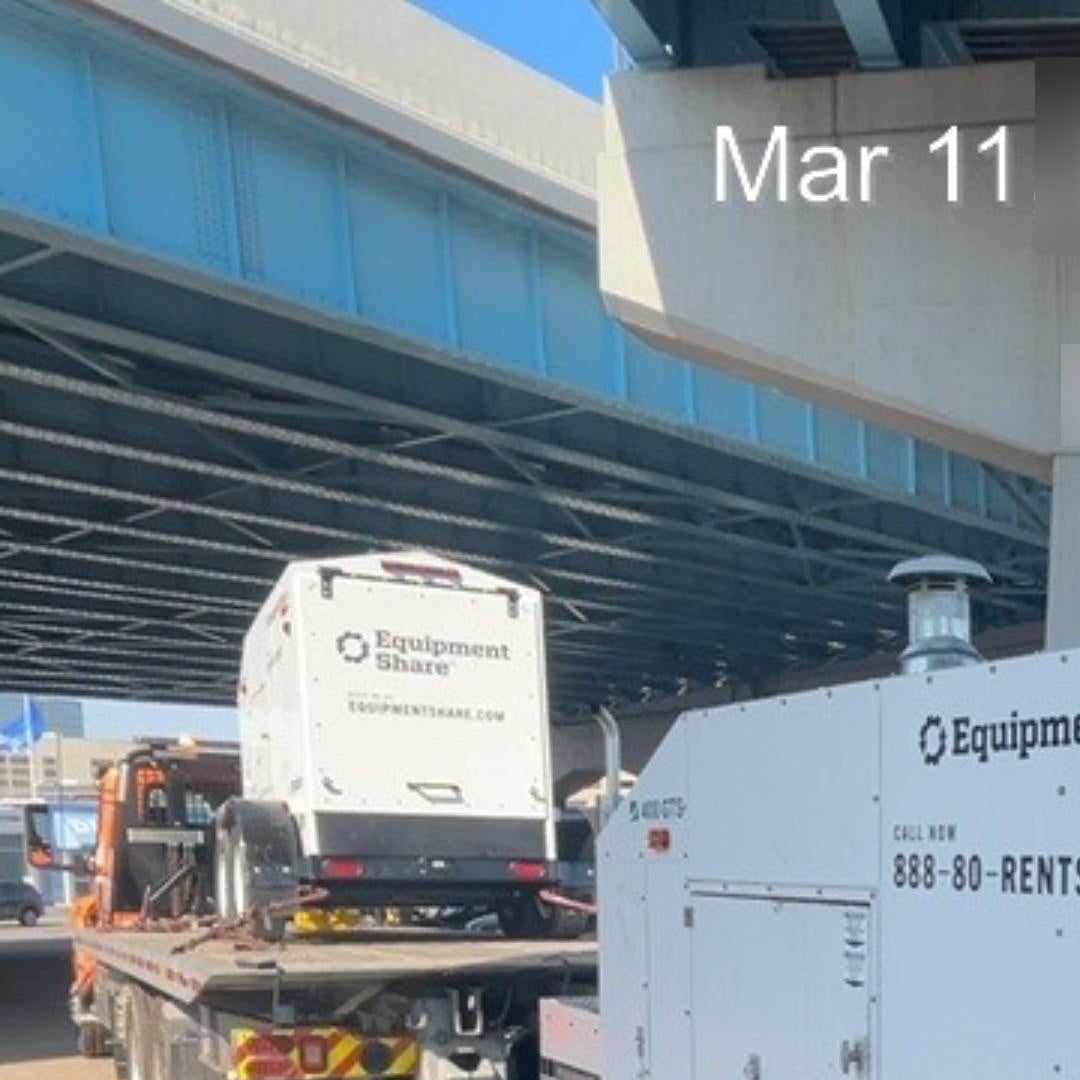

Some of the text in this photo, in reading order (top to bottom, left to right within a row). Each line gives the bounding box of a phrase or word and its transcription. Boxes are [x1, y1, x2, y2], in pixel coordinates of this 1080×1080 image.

[374, 630, 512, 659] Equipment
[375, 653, 450, 676] Share
[893, 824, 957, 841] CALL NOW
